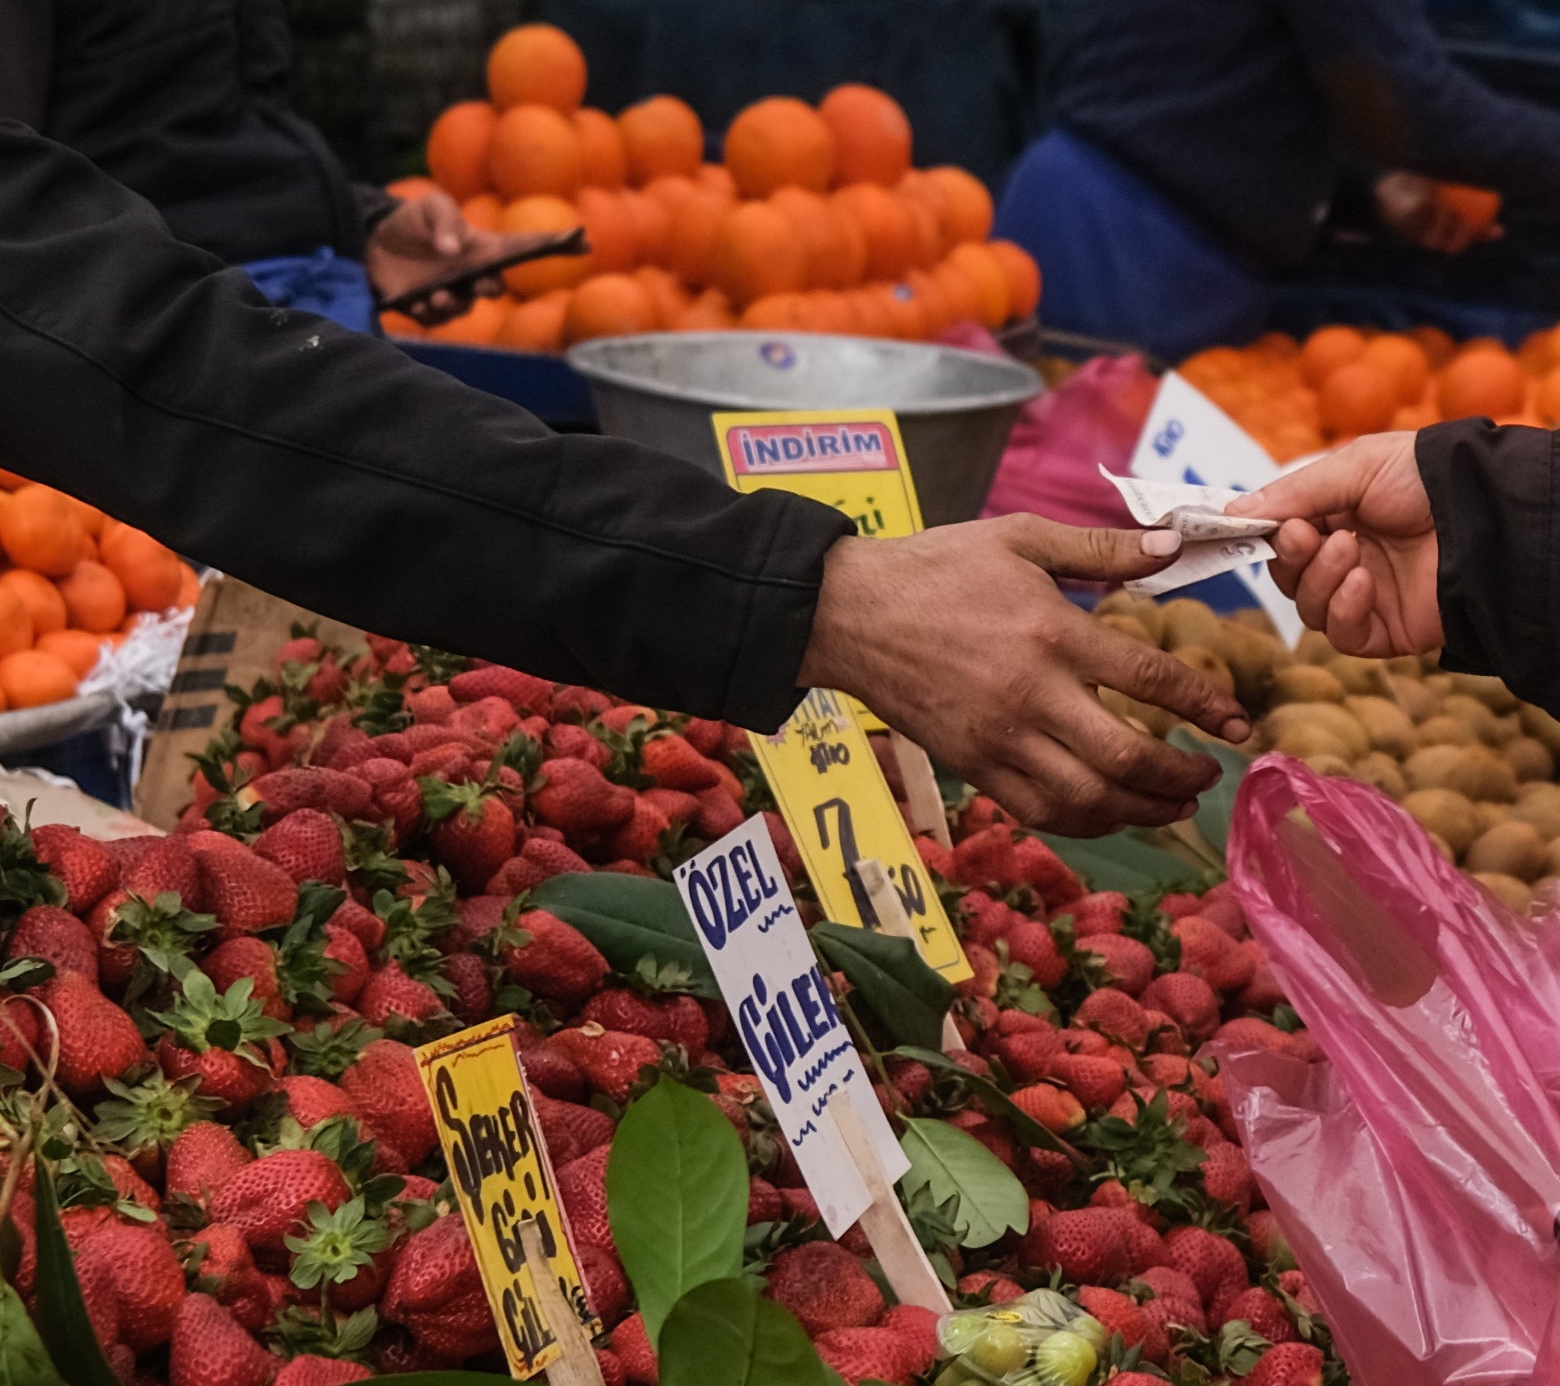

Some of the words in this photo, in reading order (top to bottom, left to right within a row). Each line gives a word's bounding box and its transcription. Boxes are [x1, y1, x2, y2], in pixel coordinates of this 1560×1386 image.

[741, 428, 882, 466] İNDİRİM
[680, 839, 779, 950] ÖZEL
[435, 1065, 551, 1226] ŞEKER
